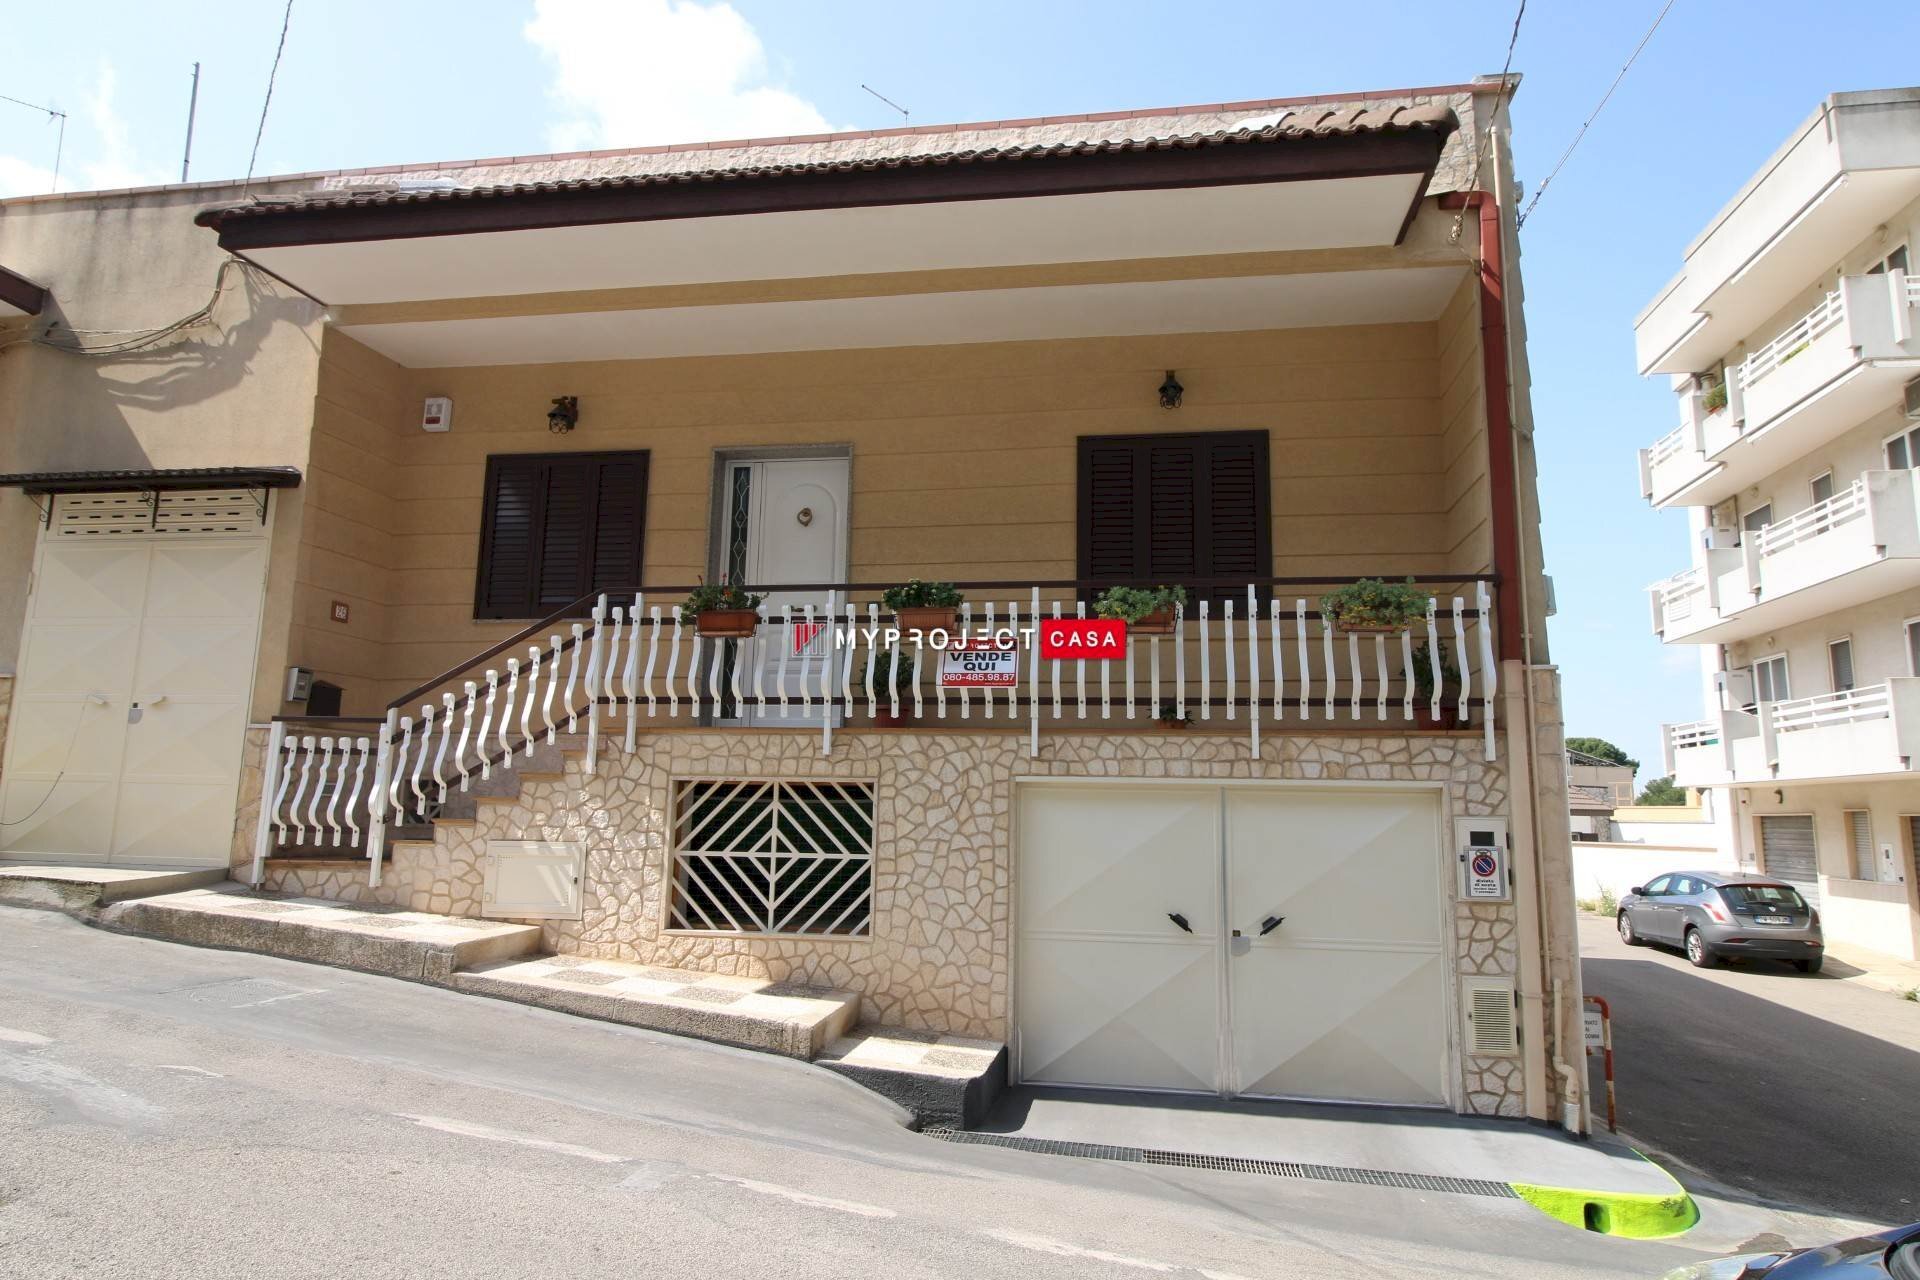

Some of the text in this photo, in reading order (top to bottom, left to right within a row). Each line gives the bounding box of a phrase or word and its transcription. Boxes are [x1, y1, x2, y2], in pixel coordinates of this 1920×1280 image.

[950, 652, 1012, 662] VENDE
[963, 662, 996, 672] QUI
[943, 673, 1015, 681] 080-485.98.87
